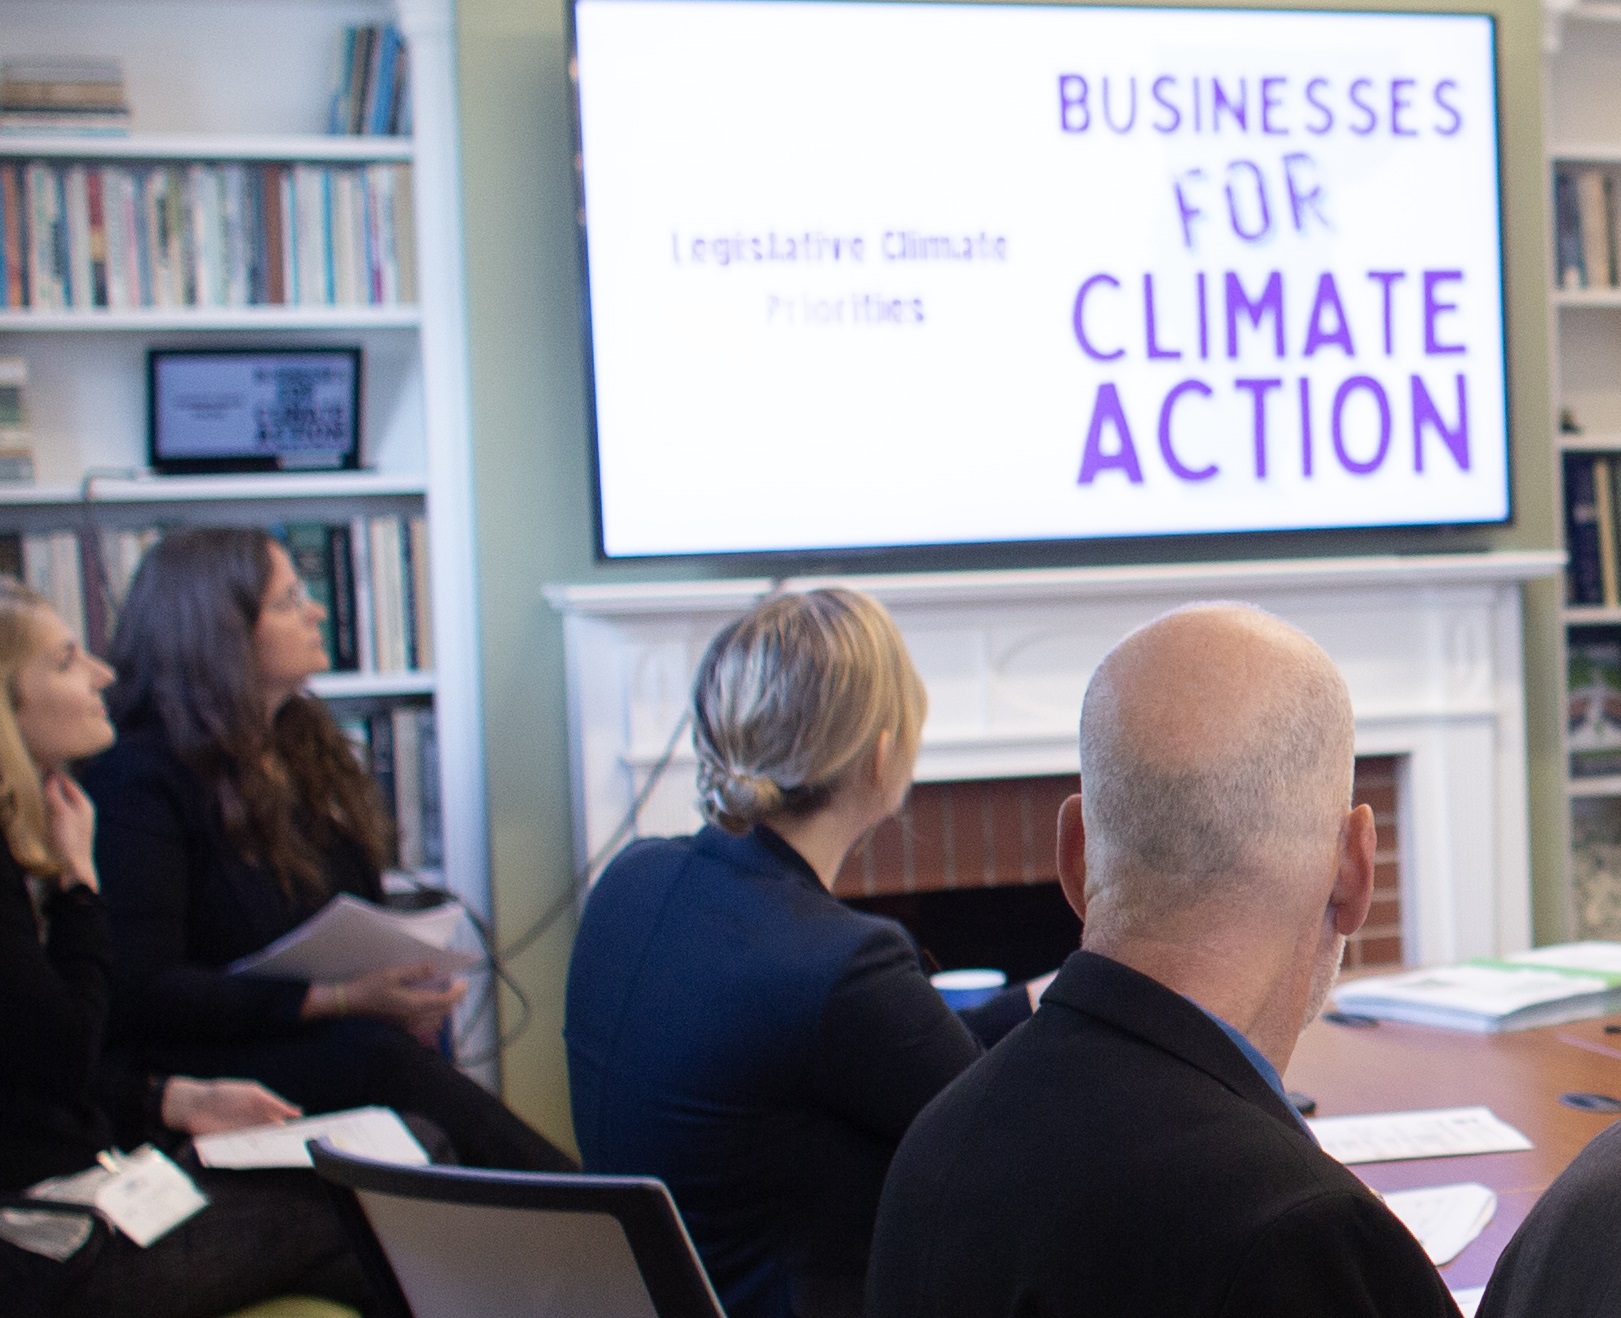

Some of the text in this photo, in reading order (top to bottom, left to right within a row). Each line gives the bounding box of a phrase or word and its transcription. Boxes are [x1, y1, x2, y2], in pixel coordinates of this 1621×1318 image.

[1059, 74, 1464, 137] BUSINESSES
[1173, 151, 1336, 248] FOR
[672, 231, 1009, 267] Legislative Climate
[766, 294, 926, 325] Priorities
[1072, 270, 1468, 362] CLIMATE
[1076, 373, 1472, 486] ACTION
